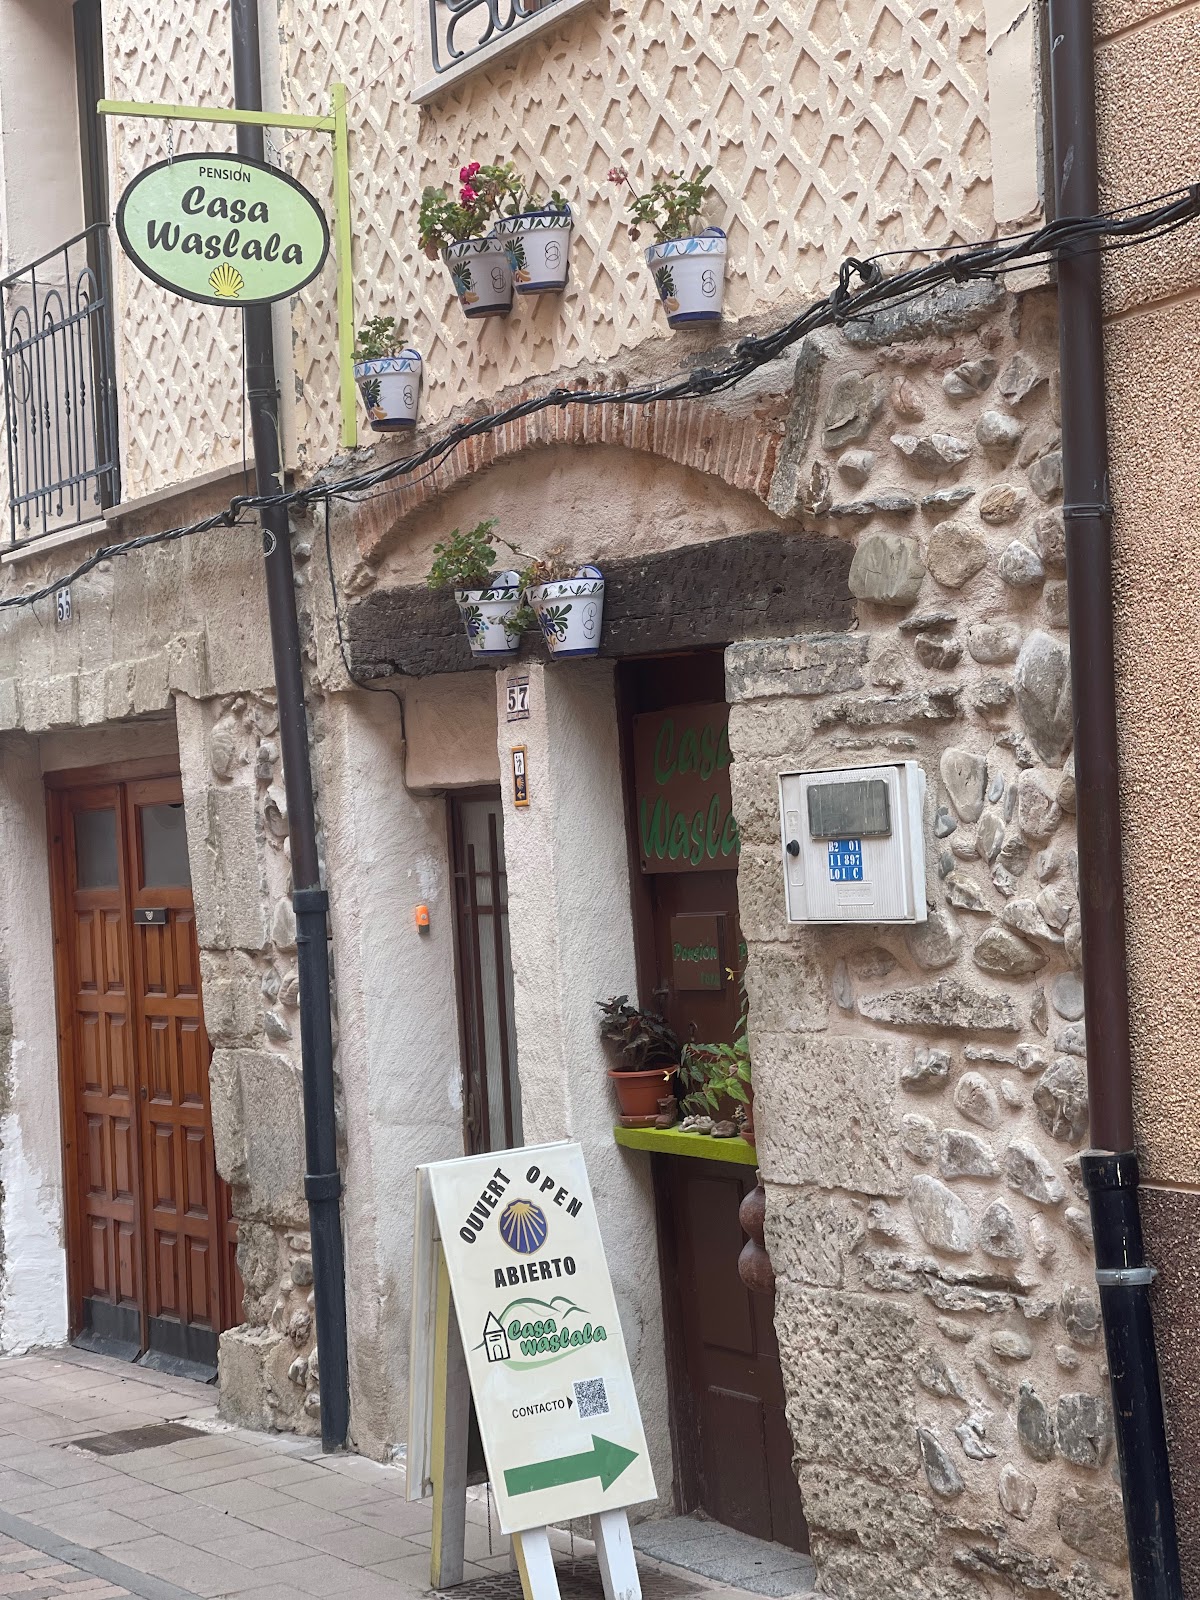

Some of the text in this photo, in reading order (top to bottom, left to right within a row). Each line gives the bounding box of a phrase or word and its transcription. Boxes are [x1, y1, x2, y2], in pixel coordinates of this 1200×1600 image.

[181, 186, 269, 224] Casa
[147, 219, 303, 265] Waslala
[508, 687, 528, 711] 57
[459, 1167, 511, 1244] OUVERT
[525, 1165, 583, 1218] OPEN
[494, 1256, 576, 1288] ABIERTO
[507, 1318, 557, 1341] Casa
[511, 1399, 566, 1419] CONTACTO
